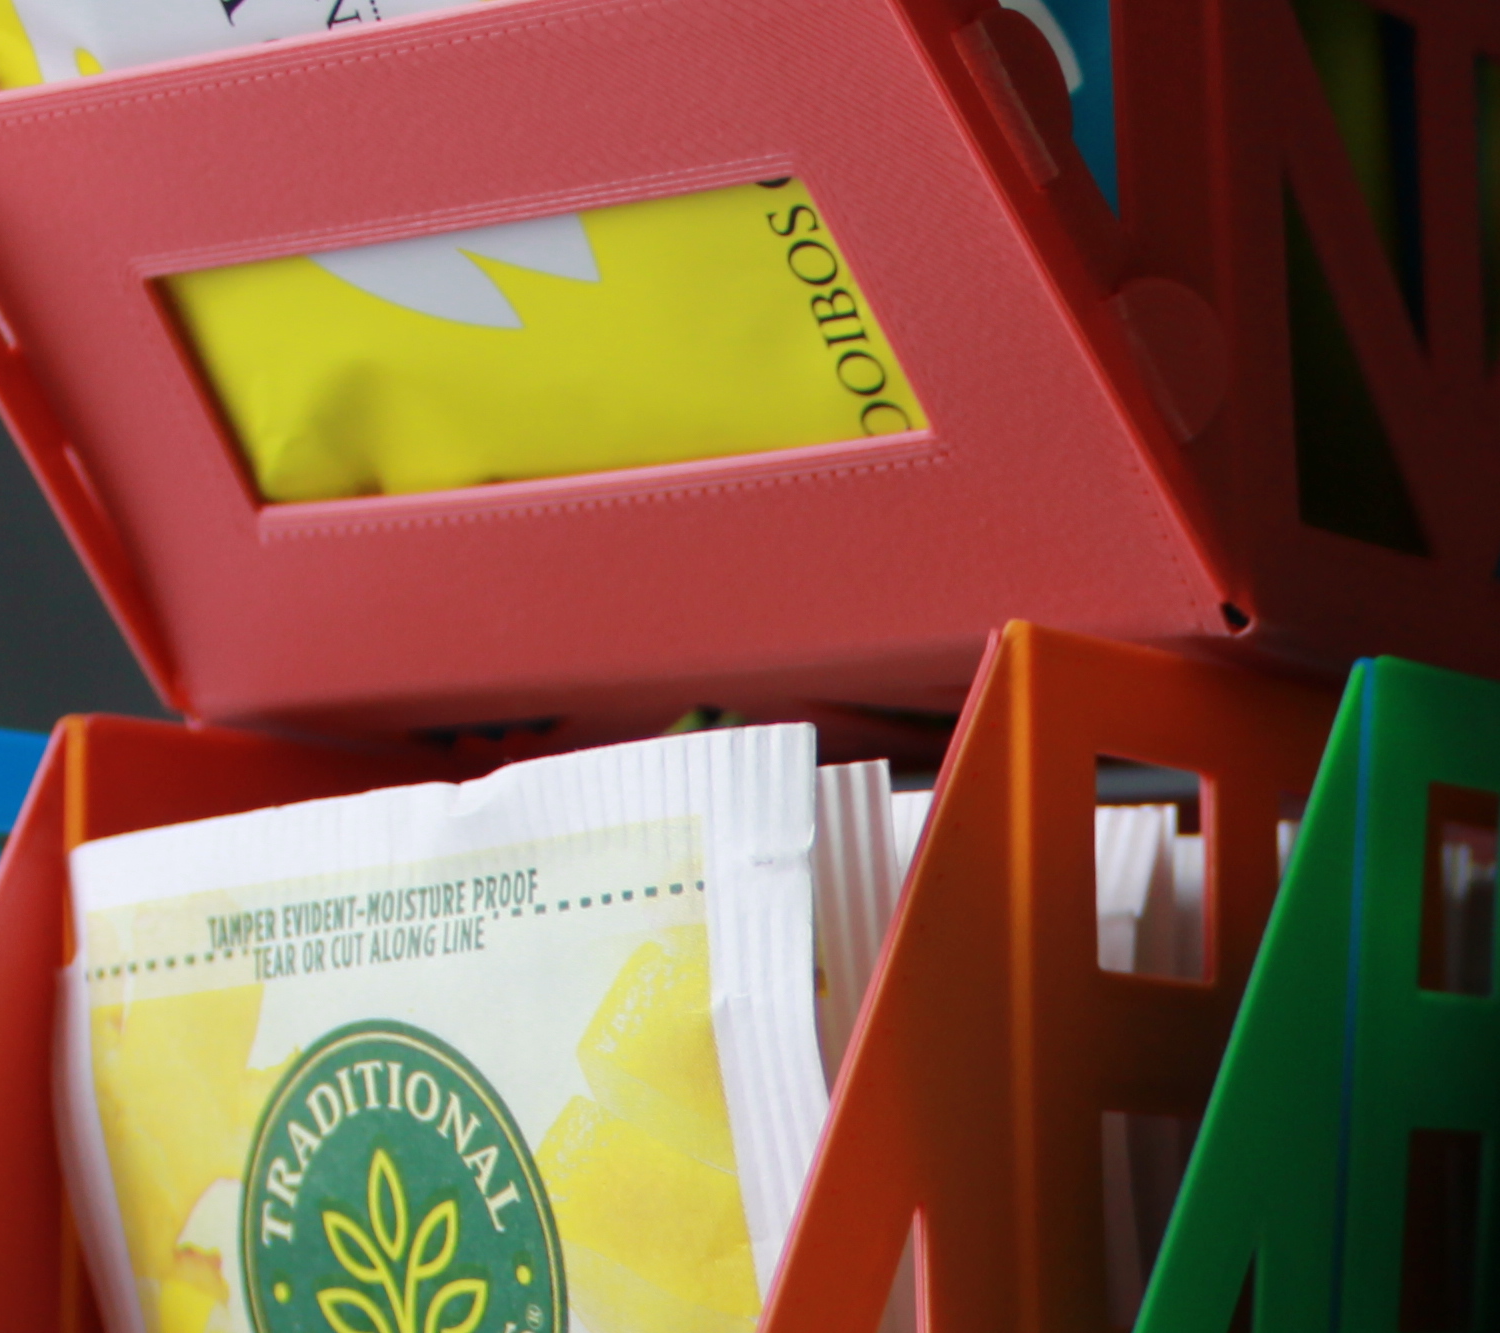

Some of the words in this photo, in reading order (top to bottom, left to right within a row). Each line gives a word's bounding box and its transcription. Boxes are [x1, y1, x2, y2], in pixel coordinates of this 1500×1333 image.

[207, 910, 274, 950] TAMPER
[282, 880, 467, 938] EVIDENT-MOISTURE
[471, 868, 538, 911] PROOF
[253, 941, 298, 981] TEAR
[301, 939, 327, 973] OR
[330, 934, 364, 969] CUT
[369, 925, 439, 966] ALONG
[442, 915, 486, 955] LINE
[261, 1060, 522, 1246] TRADITIONAL
